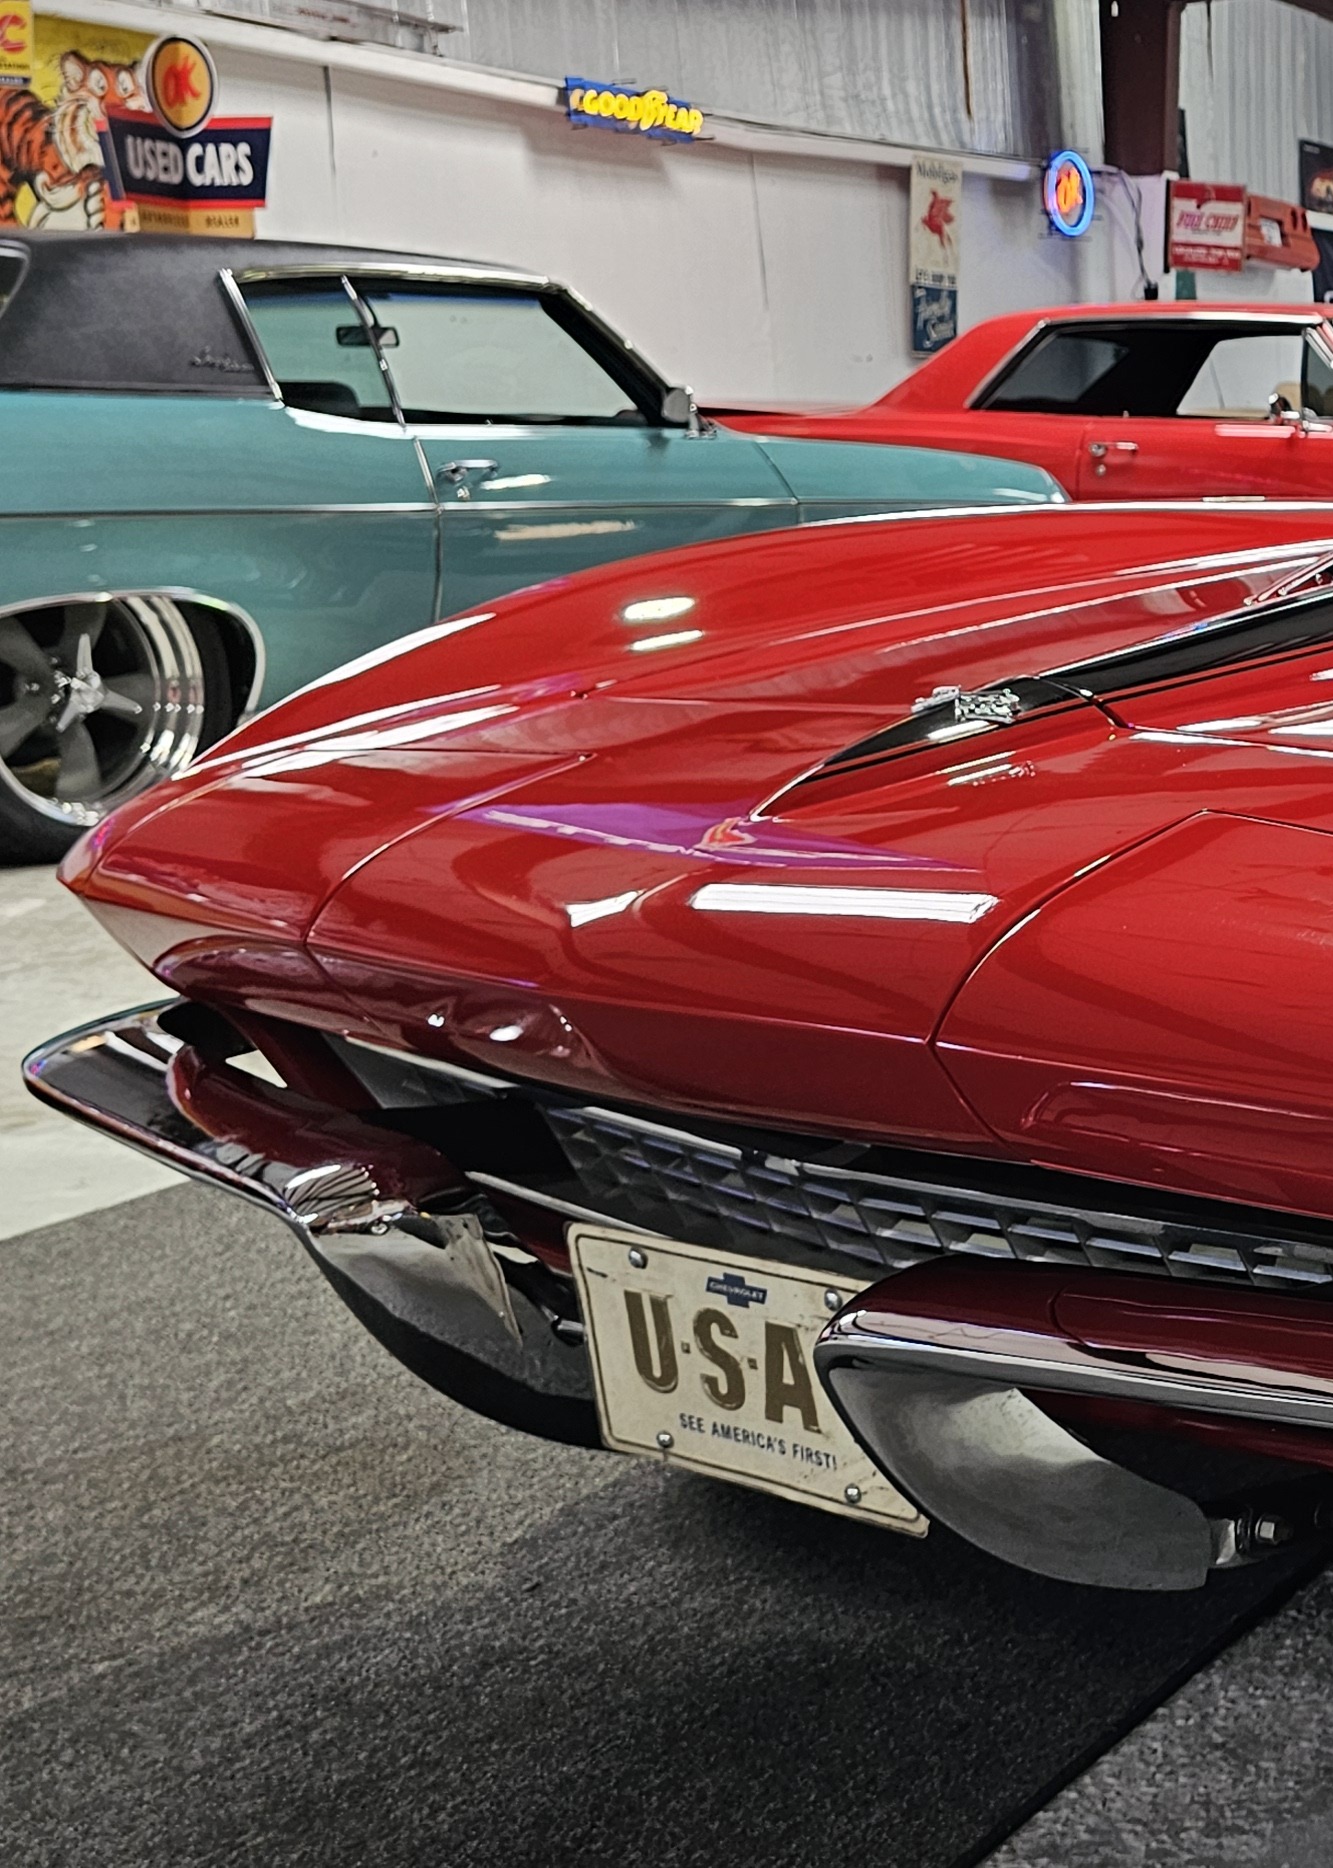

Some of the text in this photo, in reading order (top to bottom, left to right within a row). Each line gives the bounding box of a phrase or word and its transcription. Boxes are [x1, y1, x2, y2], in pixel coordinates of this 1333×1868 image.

[162, 55, 201, 108] OK
[579, 89, 704, 136] GOODYEAR
[125, 134, 254, 187] USED CARS
[708, 1279, 766, 1301] CHEVROLET
[679, 1412, 837, 1471] SEE AMERICA'S FIRST!
